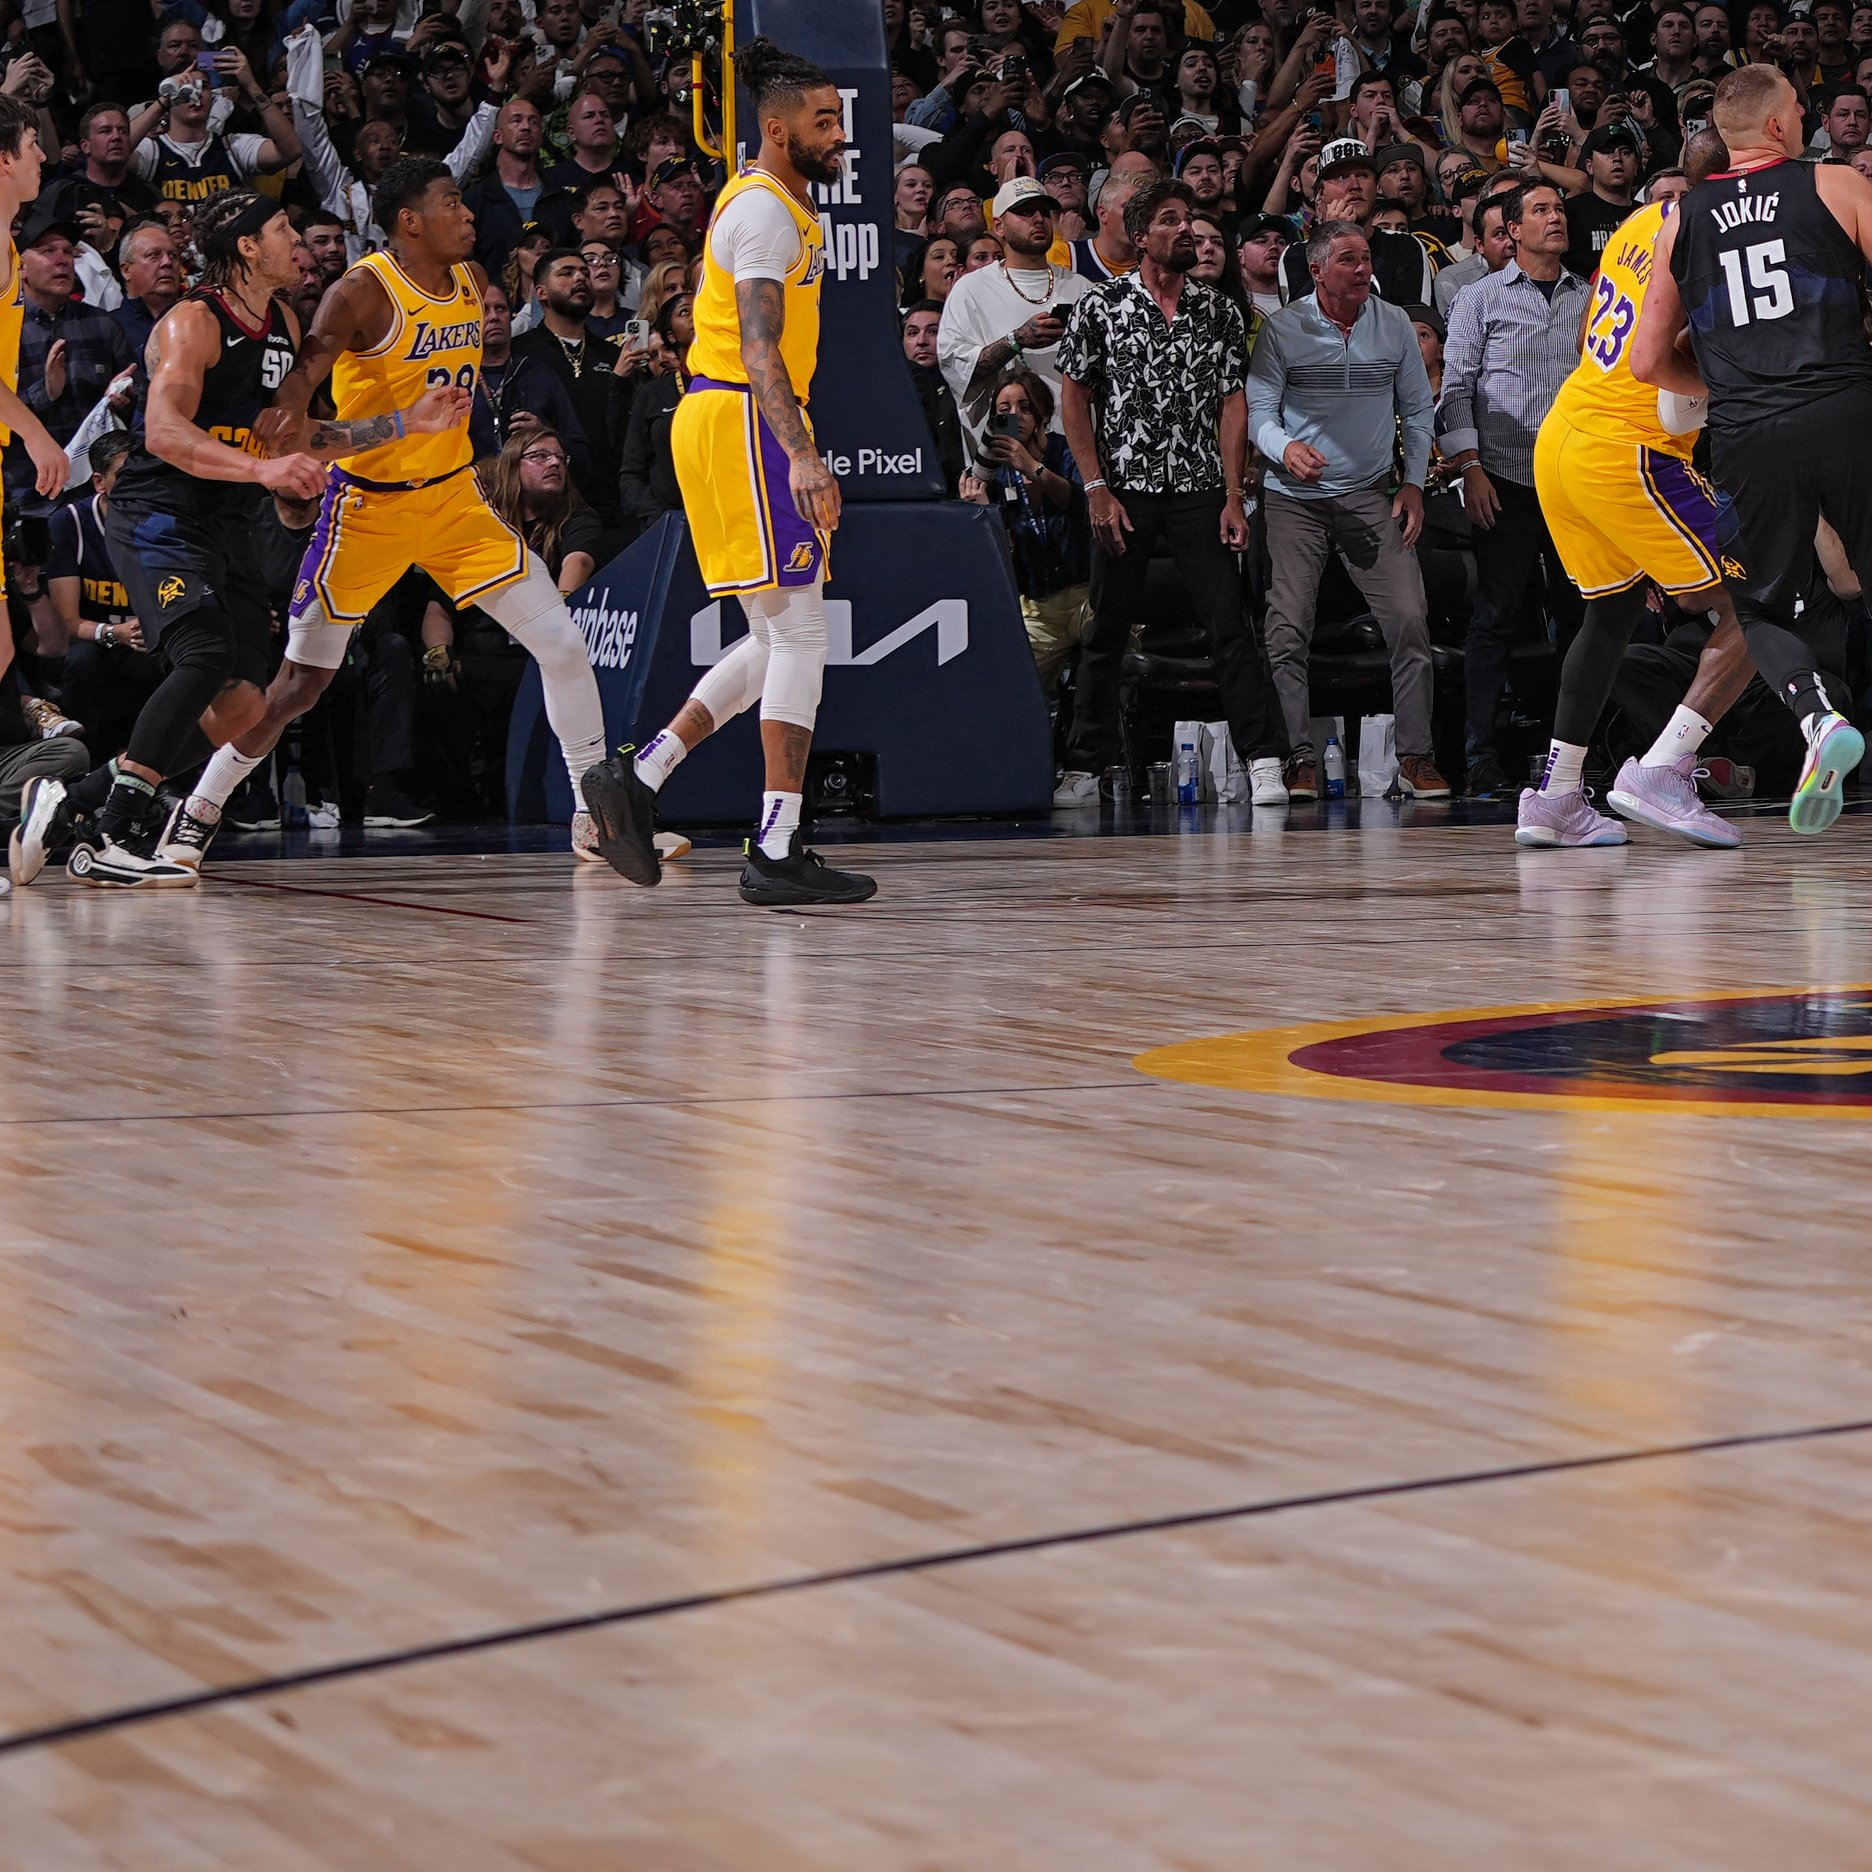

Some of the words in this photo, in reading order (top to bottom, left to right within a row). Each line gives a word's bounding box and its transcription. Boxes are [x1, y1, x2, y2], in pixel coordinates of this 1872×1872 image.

[160, 175, 230, 202] DENVER
[808, 150, 862, 204] HE
[1711, 192, 1780, 234] JOKIĆ
[814, 211, 880, 282] App
[1616, 242, 1652, 286] JAMES
[1719, 238, 1794, 328] 15
[403, 321, 483, 361] LAKERS
[1585, 274, 1637, 374] 23
[262, 348, 294, 389] 50
[858, 448, 922, 475] Pixel
